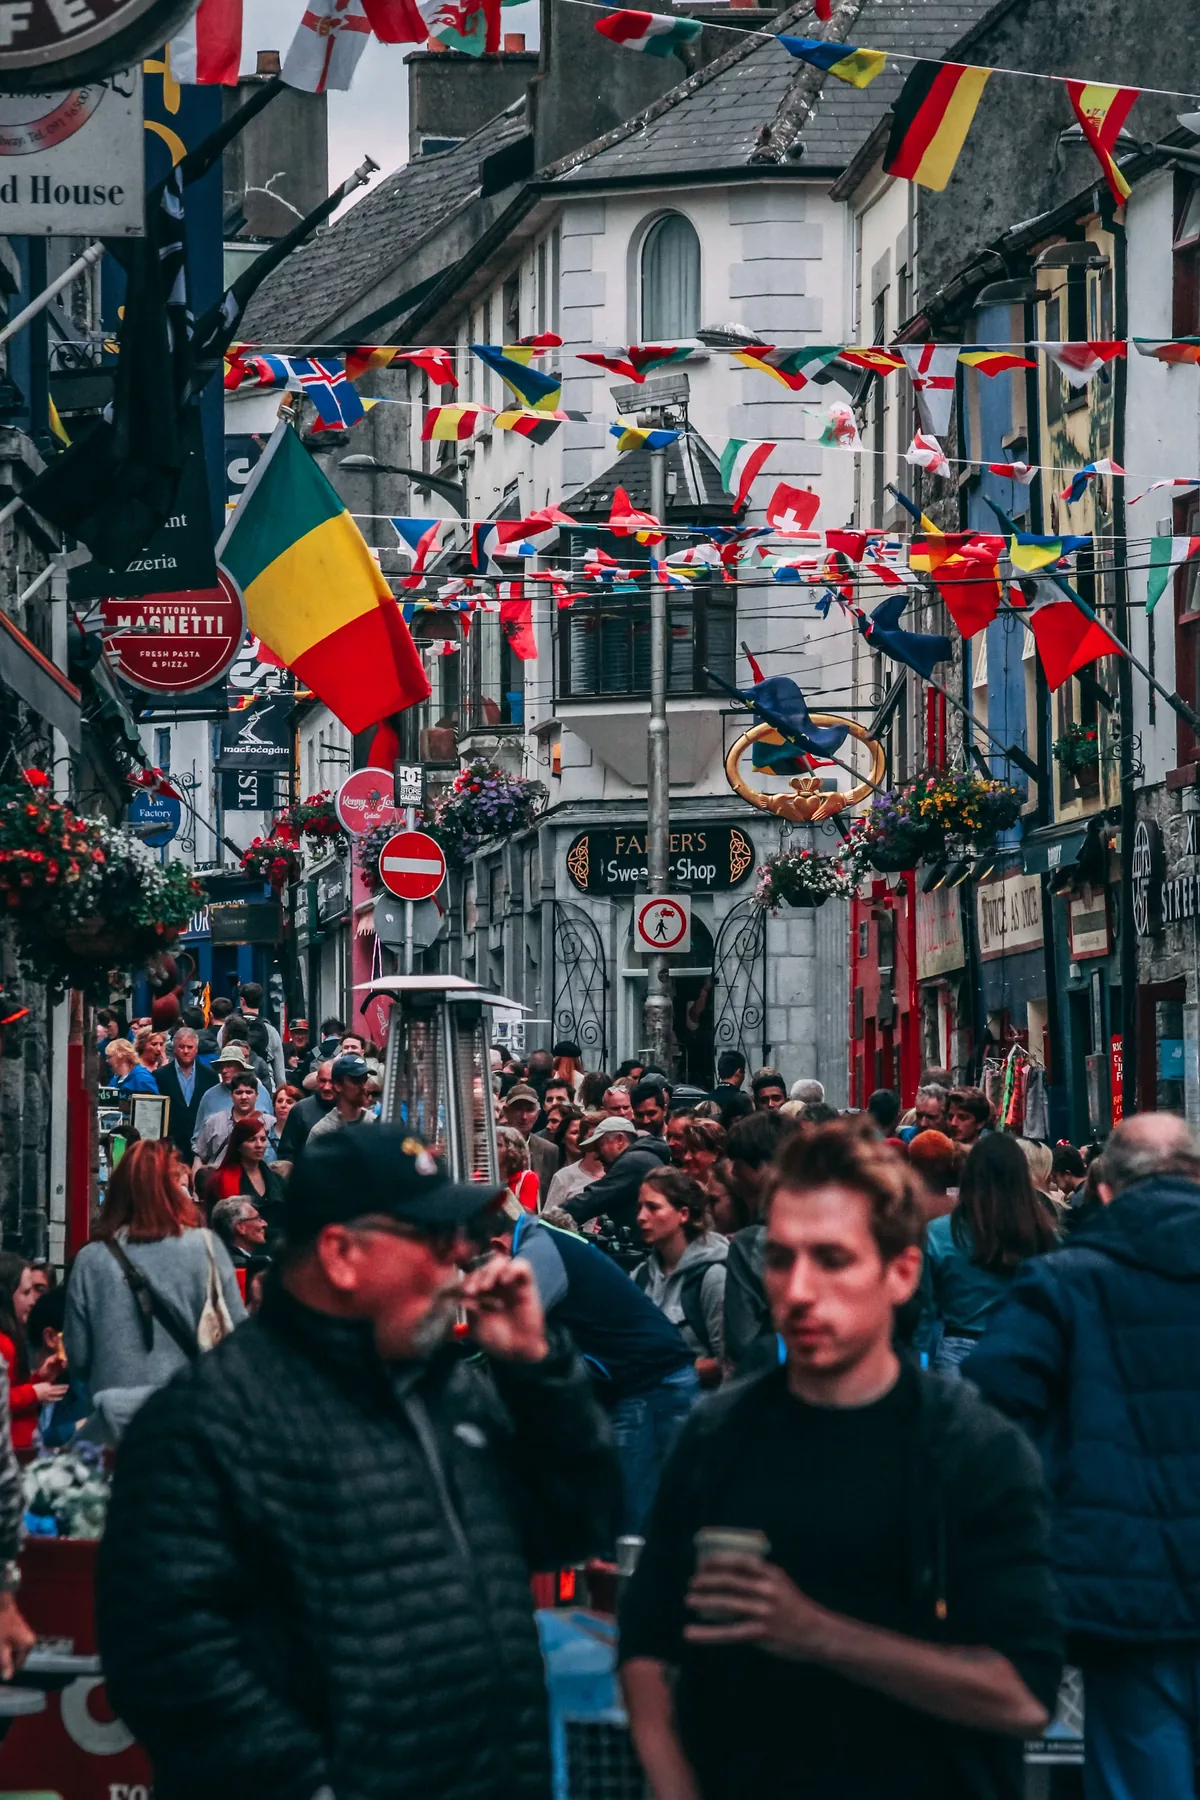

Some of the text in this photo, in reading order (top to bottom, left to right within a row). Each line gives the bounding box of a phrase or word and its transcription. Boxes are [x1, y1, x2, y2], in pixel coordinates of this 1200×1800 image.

[30, 175, 125, 206] House
[143, 606, 198, 615] TRATTORIA
[117, 615, 223, 634] MAGNETTI
[140, 650, 200, 658] FRESH PASTA
[400, 787, 422, 795] STORE
[139, 808, 172, 820] Factory
[615, 832, 707, 855] FAER'S
[676, 858, 716, 885] Shop
